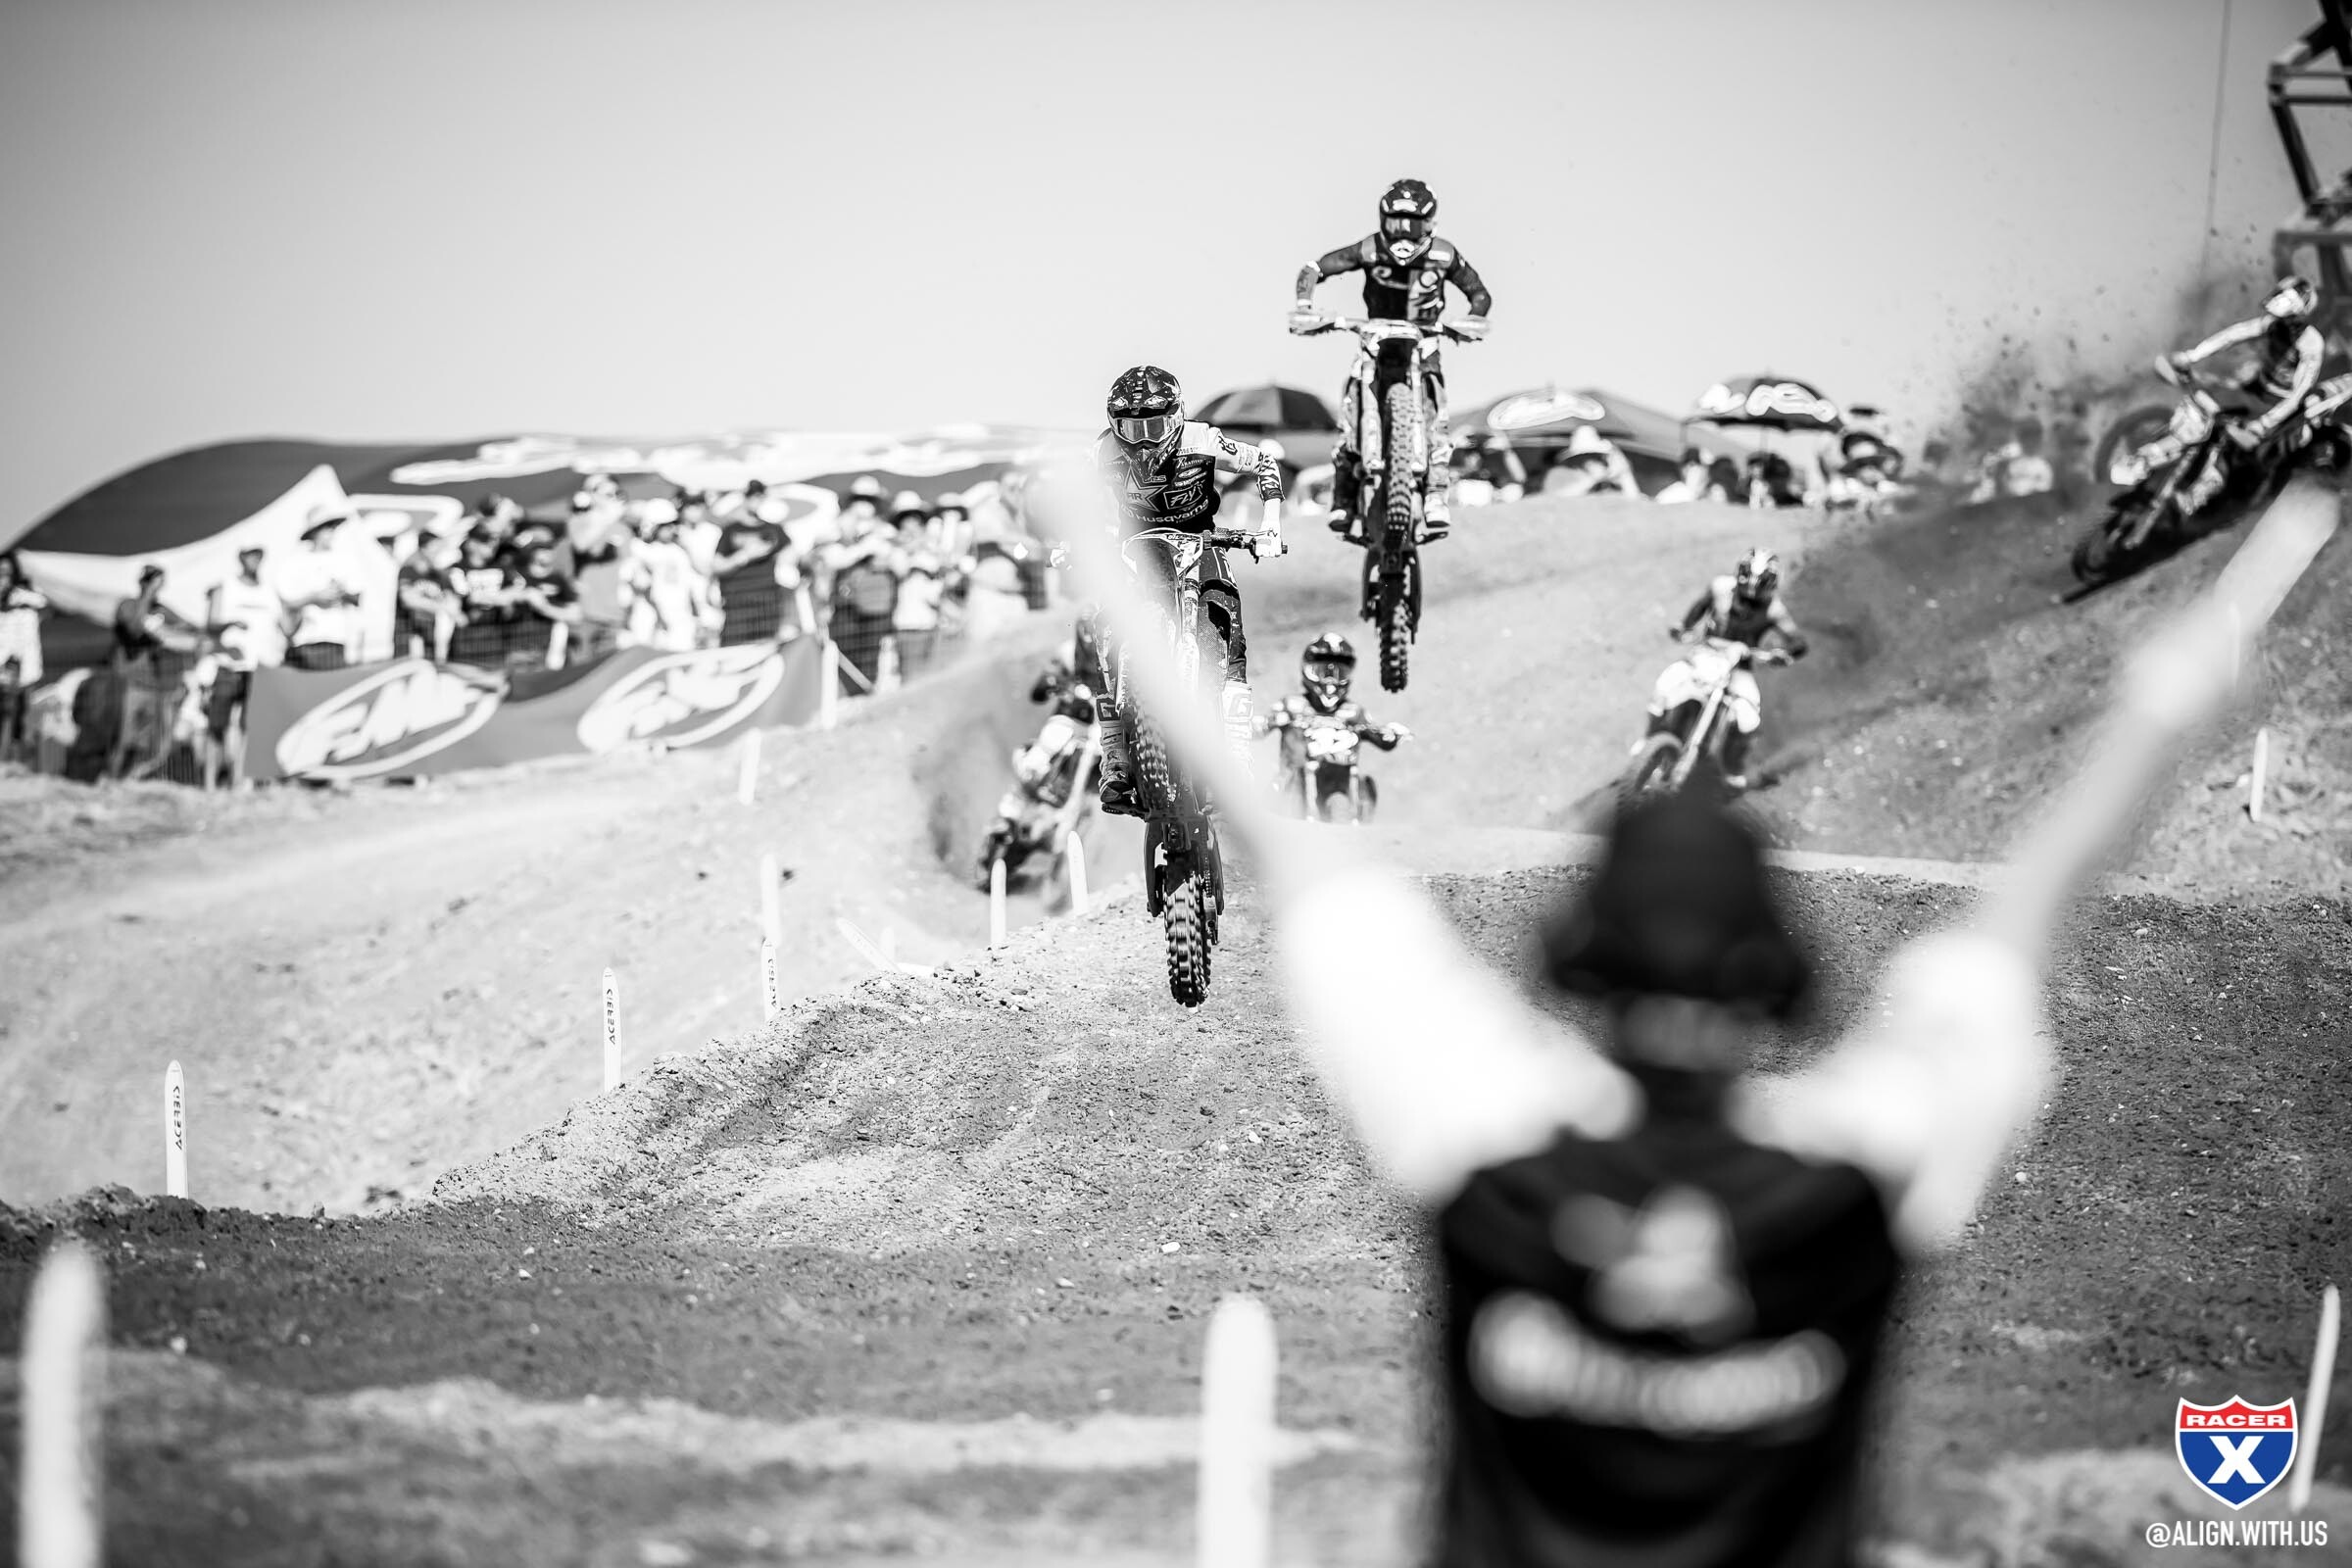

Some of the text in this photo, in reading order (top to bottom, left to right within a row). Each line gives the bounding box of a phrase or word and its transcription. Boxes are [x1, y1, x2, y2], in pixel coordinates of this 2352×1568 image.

[1135, 499, 1209, 523] Husqvarna
[1170, 486, 1197, 507] FLY
[606, 988, 616, 1046] ACERBIS
[172, 1085, 183, 1151] ACERBIS
